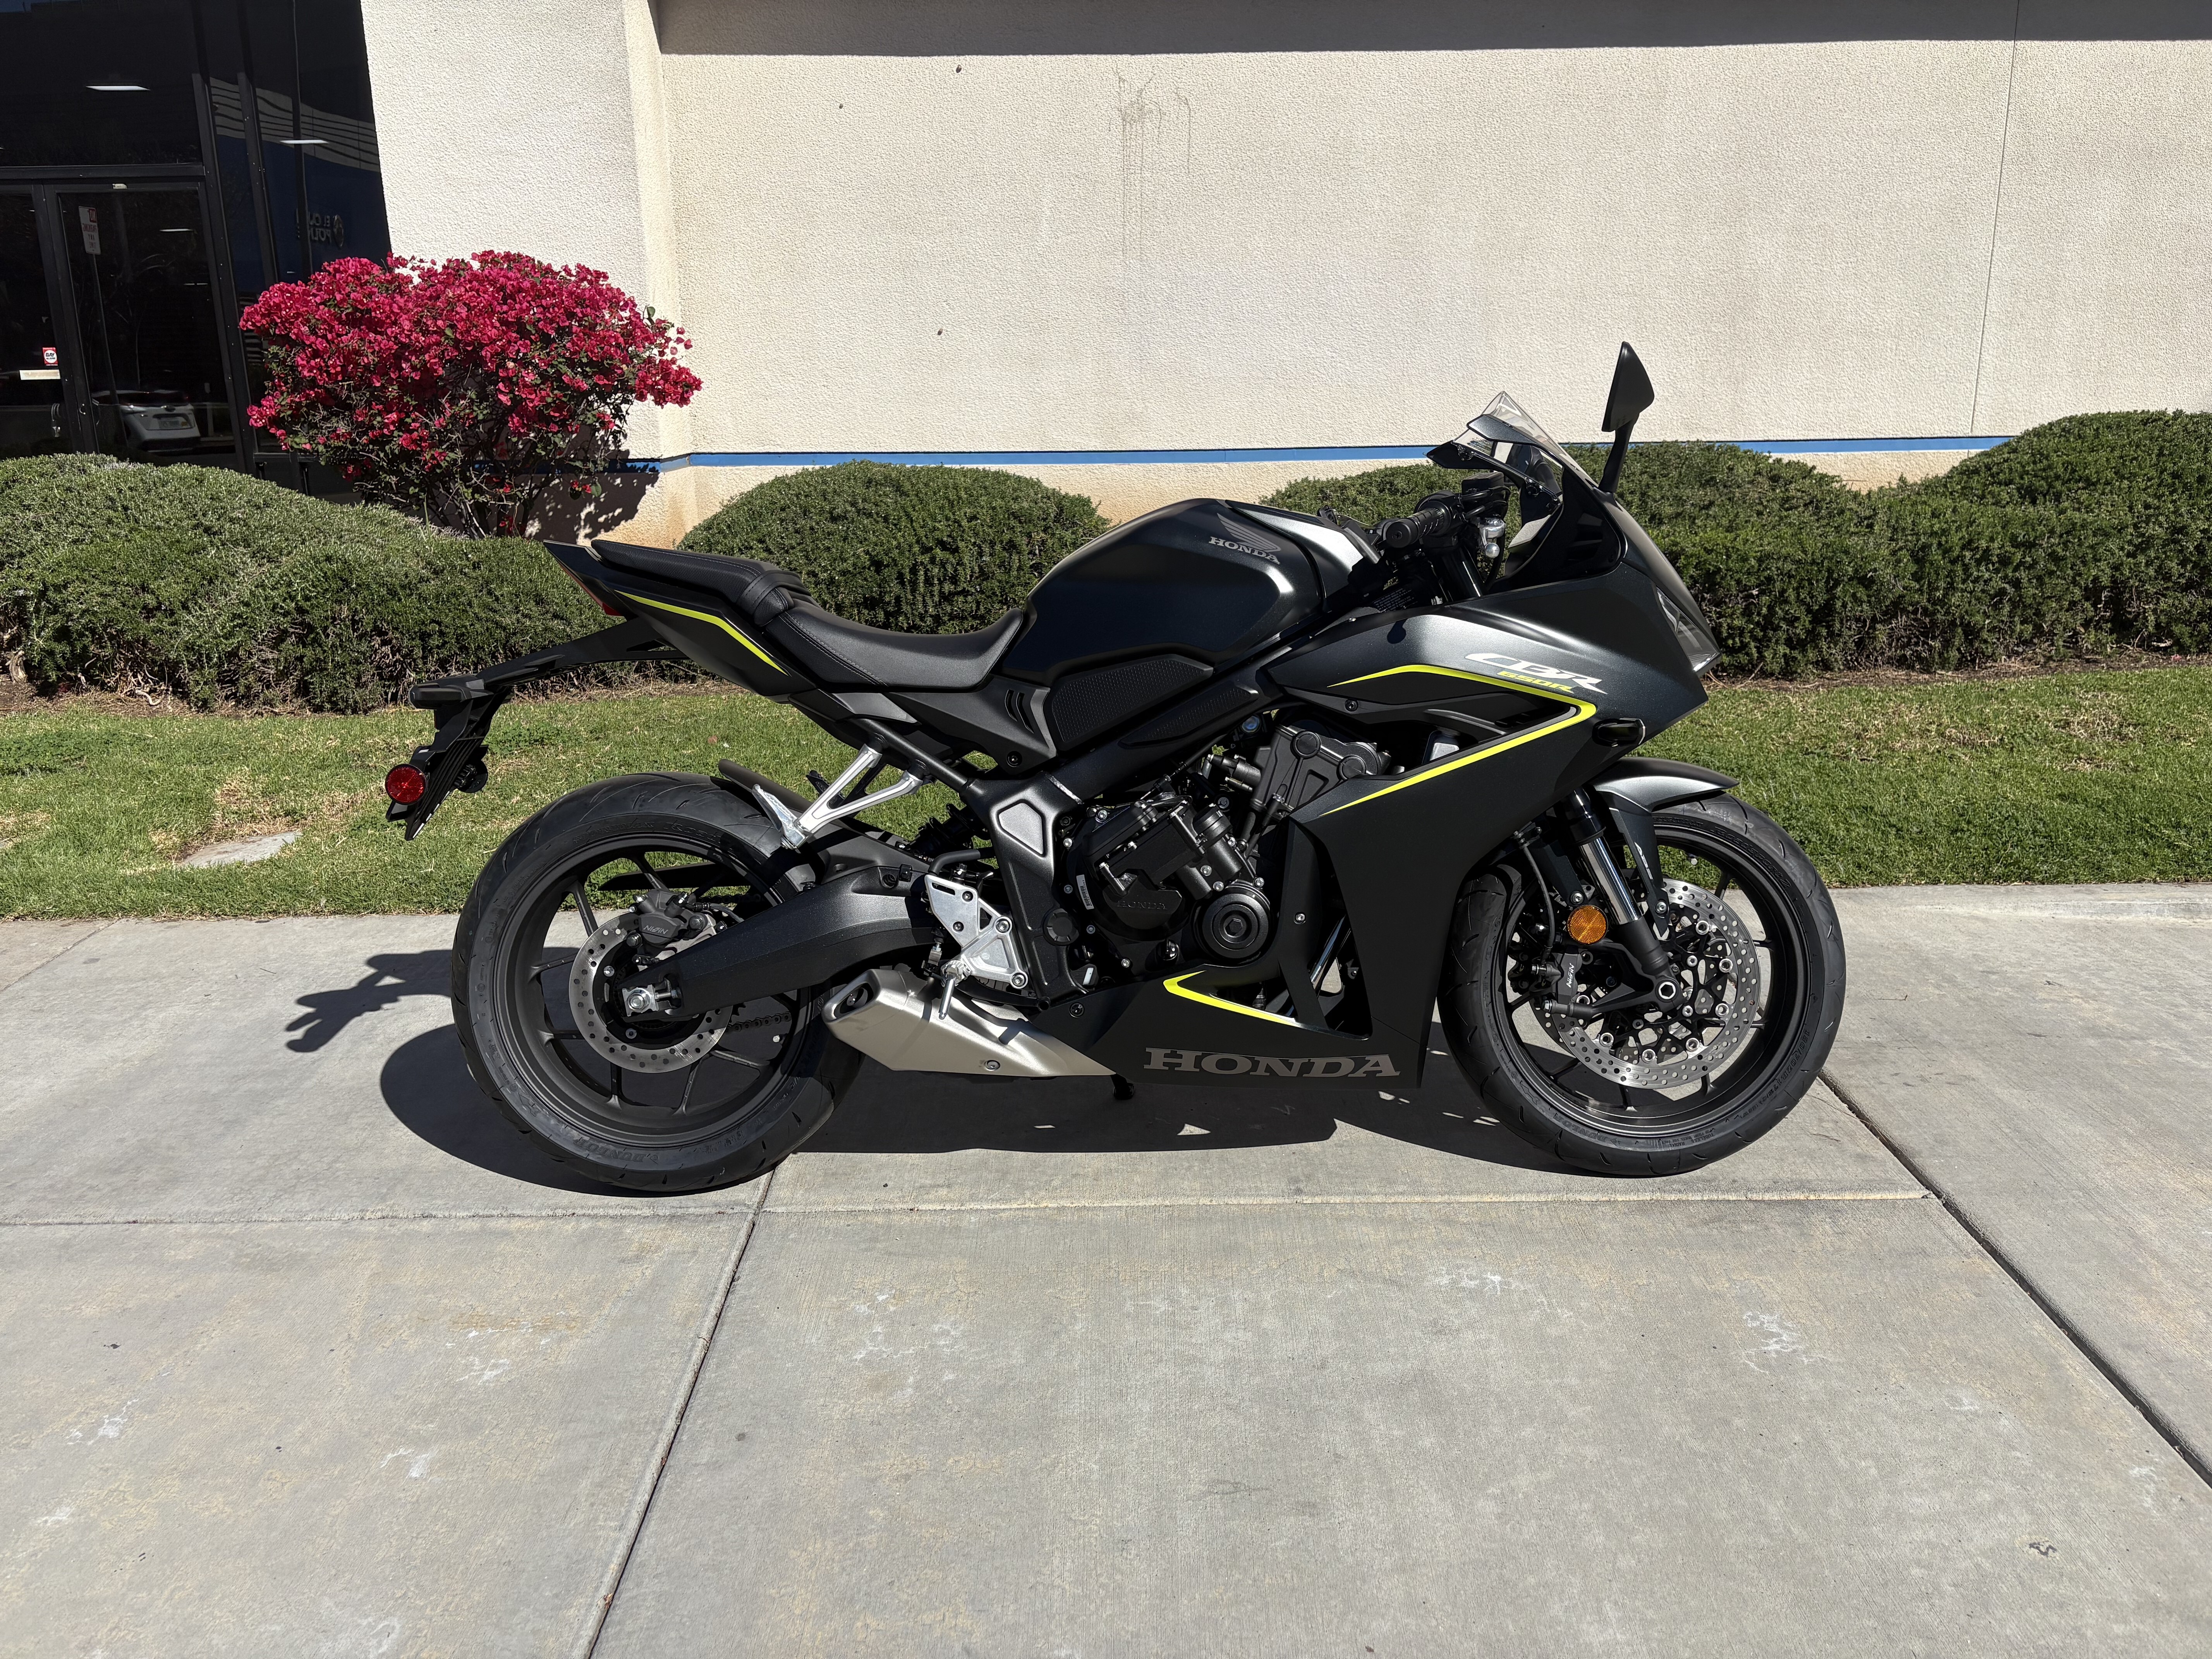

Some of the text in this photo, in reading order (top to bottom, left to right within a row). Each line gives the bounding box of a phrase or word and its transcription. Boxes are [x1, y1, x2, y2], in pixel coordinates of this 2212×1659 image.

[1209, 536, 1280, 565] HONDA
[1465, 653, 1608, 694] CBR
[1497, 670, 1574, 694] 650R
[1117, 900, 1168, 910] HONDA
[643, 925, 669, 935] NISSIN
[1144, 1047, 1400, 1078] HONDA
[1553, 1114, 1608, 1142] DUNLOP
[573, 1139, 647, 1163] DUNLOP
